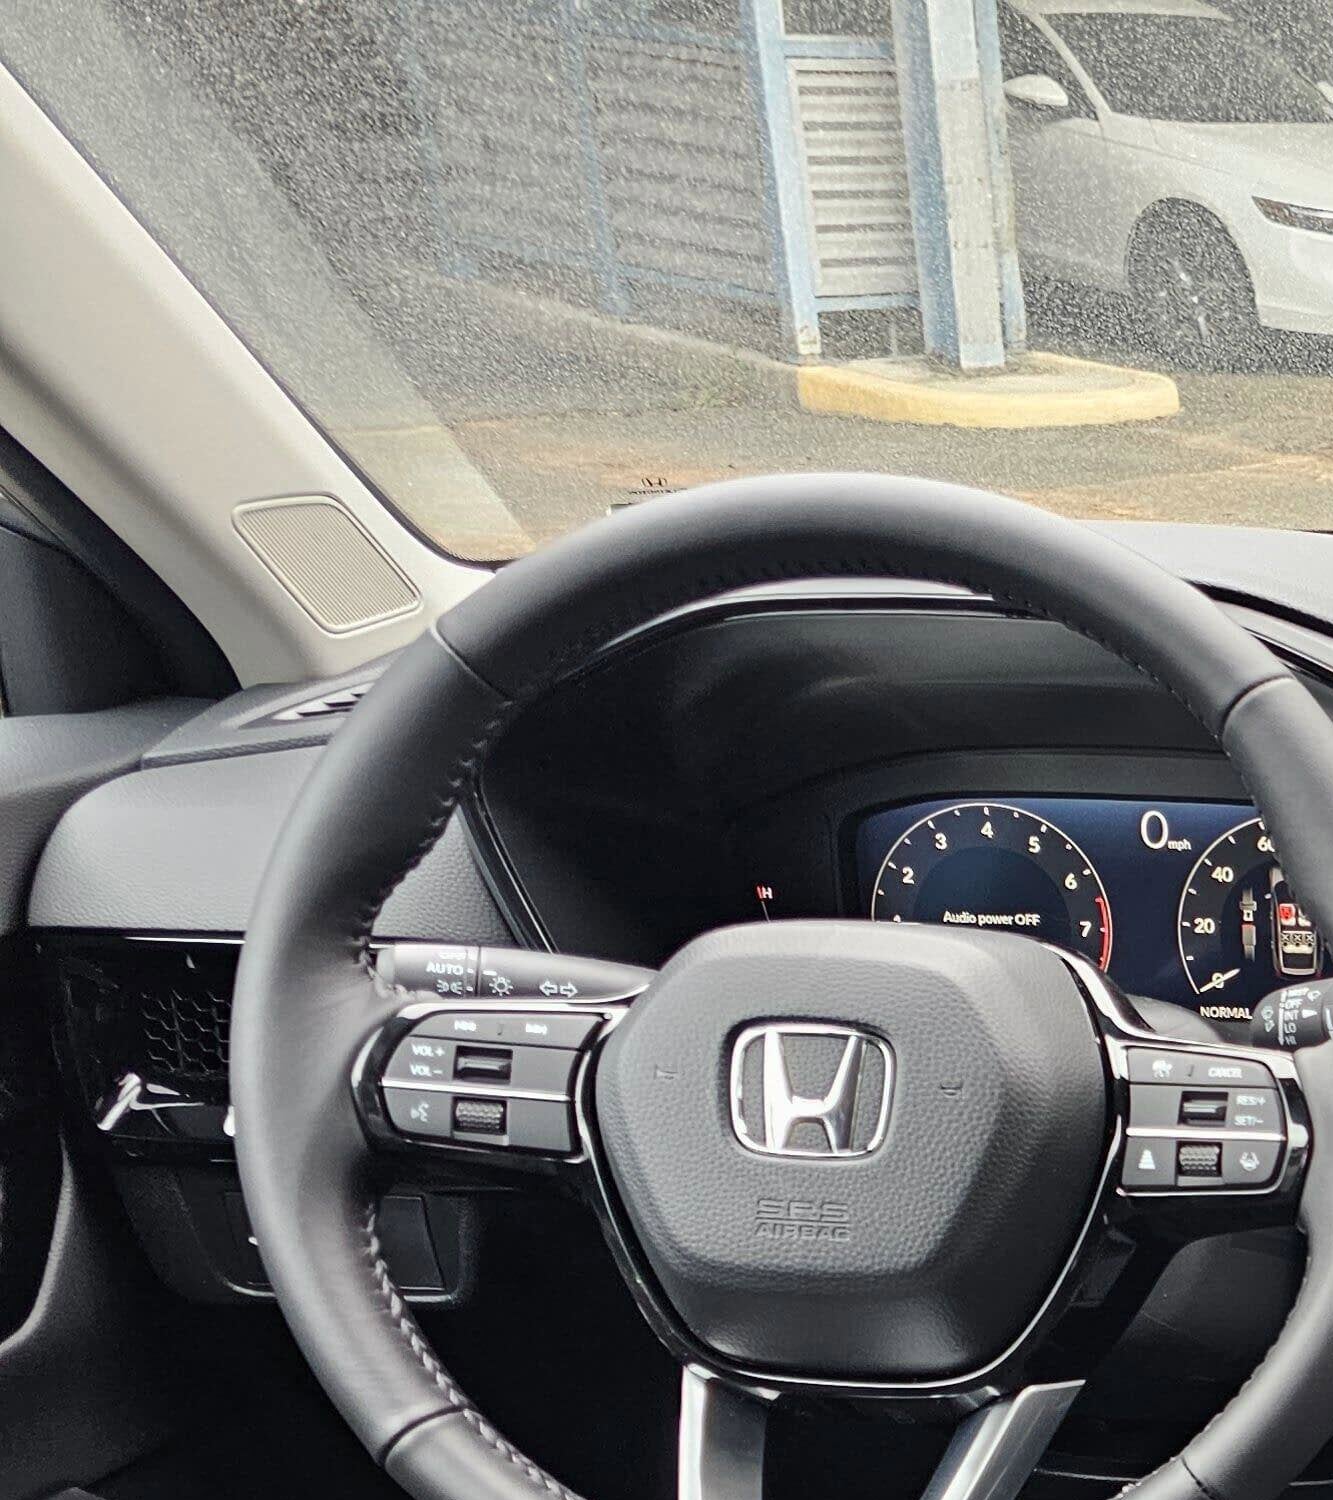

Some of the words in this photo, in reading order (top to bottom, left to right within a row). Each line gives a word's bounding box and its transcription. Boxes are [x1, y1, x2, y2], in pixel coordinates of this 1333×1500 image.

[980, 821, 994, 839] 4
[1141, 810, 1169, 849] 0
[1168, 839, 1191, 851] mph
[935, 833, 948, 850] 3
[1028, 836, 1041, 854] 5
[902, 867, 915, 885] 2
[1064, 873, 1078, 890] 6
[1212, 866, 1234, 882] 40
[943, 911, 977, 924] Audio
[978, 913, 1013, 927] power
[1014, 913, 1041, 926] OFF
[1194, 918, 1215, 934] 20
[1080, 921, 1091, 938] 7
[426, 962, 464, 975] AUTO
[1200, 1006, 1252, 1019] NORMAL
[1284, 1022, 1297, 1034] LO
